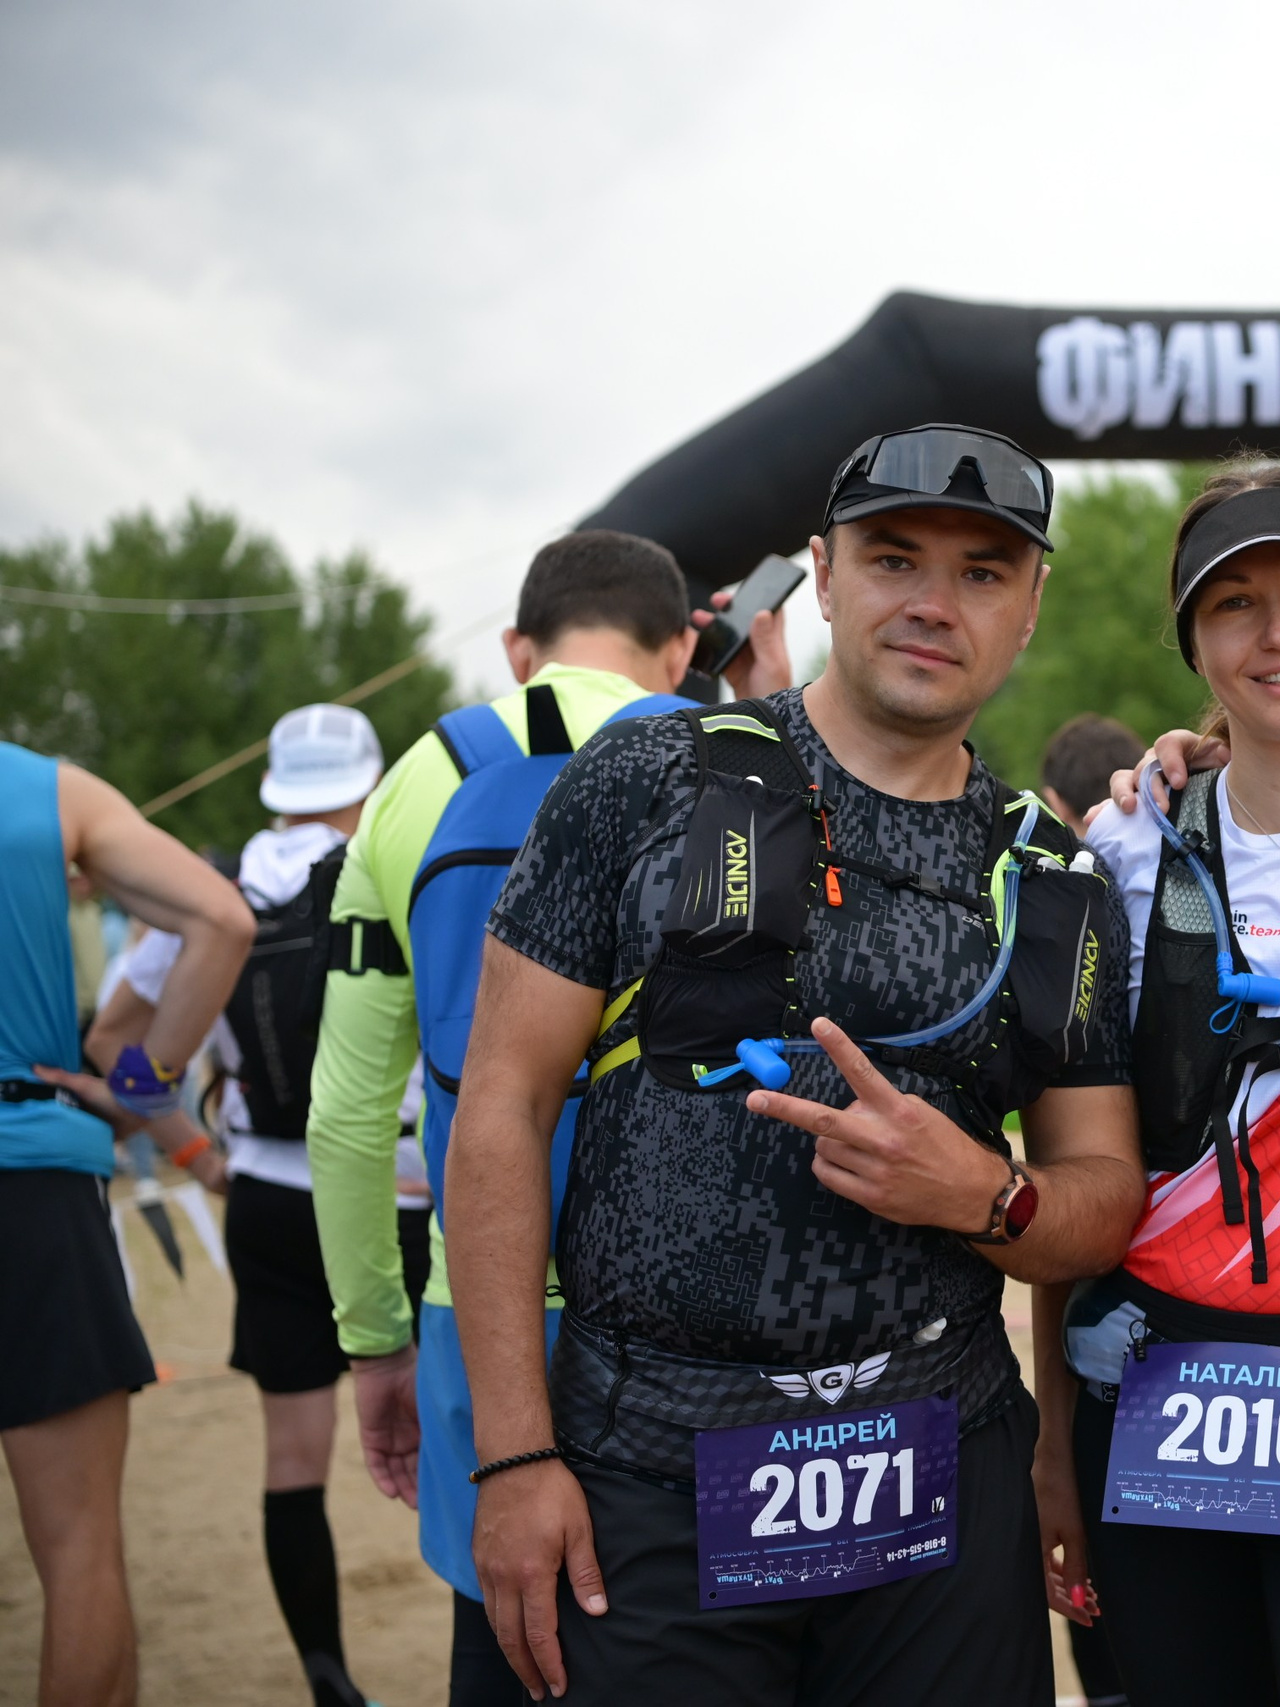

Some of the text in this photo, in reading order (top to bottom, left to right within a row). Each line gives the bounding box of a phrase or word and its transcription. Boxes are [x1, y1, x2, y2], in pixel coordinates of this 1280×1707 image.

[724, 829, 749, 918] AONIJIE
[1074, 929, 1100, 1022] AONIJIE
[820, 1371, 843, 1390] G
[768, 1412, 896, 1452] АНДРЕЙ
[750, 1447, 914, 1537] 2071
